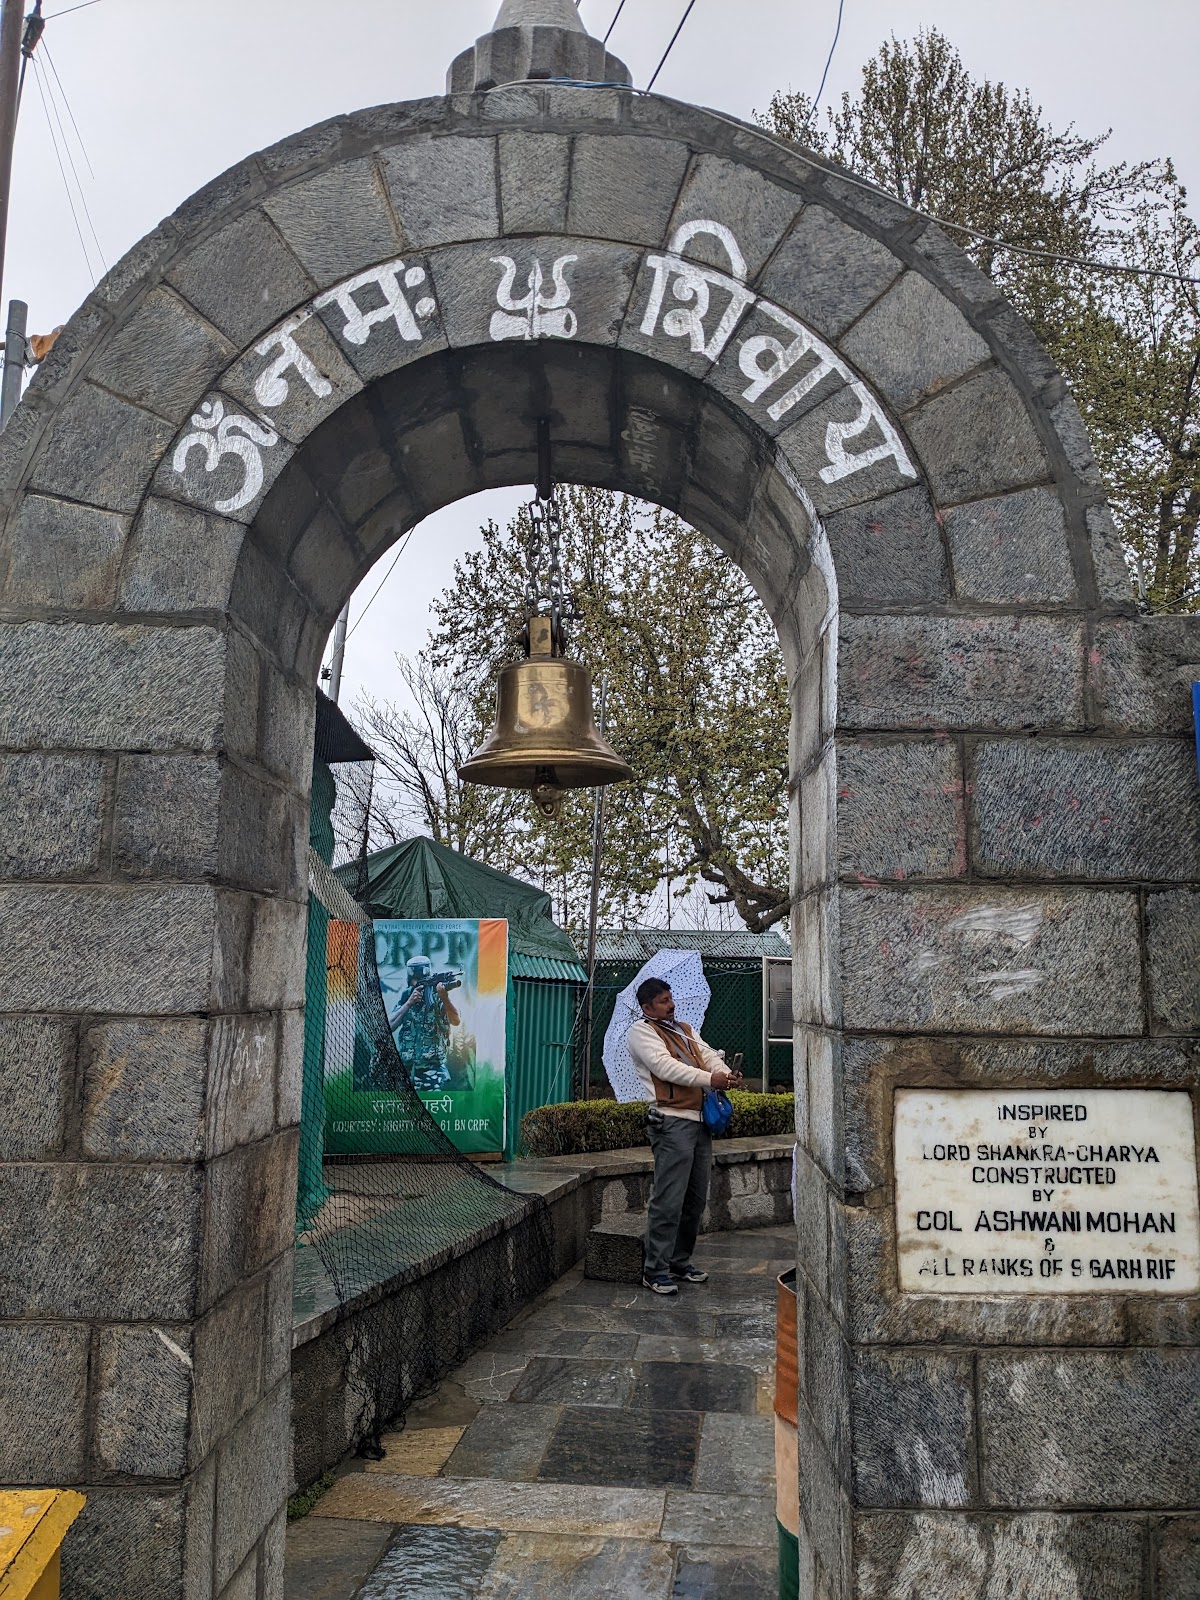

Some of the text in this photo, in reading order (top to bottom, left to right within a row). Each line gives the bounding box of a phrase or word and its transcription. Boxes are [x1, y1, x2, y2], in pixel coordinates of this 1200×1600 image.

[173, 219, 918, 512] ॐ नमः शिवाय
[998, 1104, 1088, 1121] INSPIRED
[440, 1119, 450, 1132] 61
[454, 1119, 466, 1132] BN
[468, 1119, 490, 1131] CRPF
[1028, 1127, 1048, 1139] BY
[923, 1144, 1160, 1163] LORD SHANKRA-CHARYA
[972, 1166, 1116, 1185] CONSTRUCTED
[1032, 1189, 1055, 1202] BY
[916, 1210, 1177, 1234] COL ASHWANI MOHAN
[918, 1257, 956, 1277] ALL
[962, 1258, 1033, 1278] RANKS
[1039, 1258, 1063, 1278] OF
